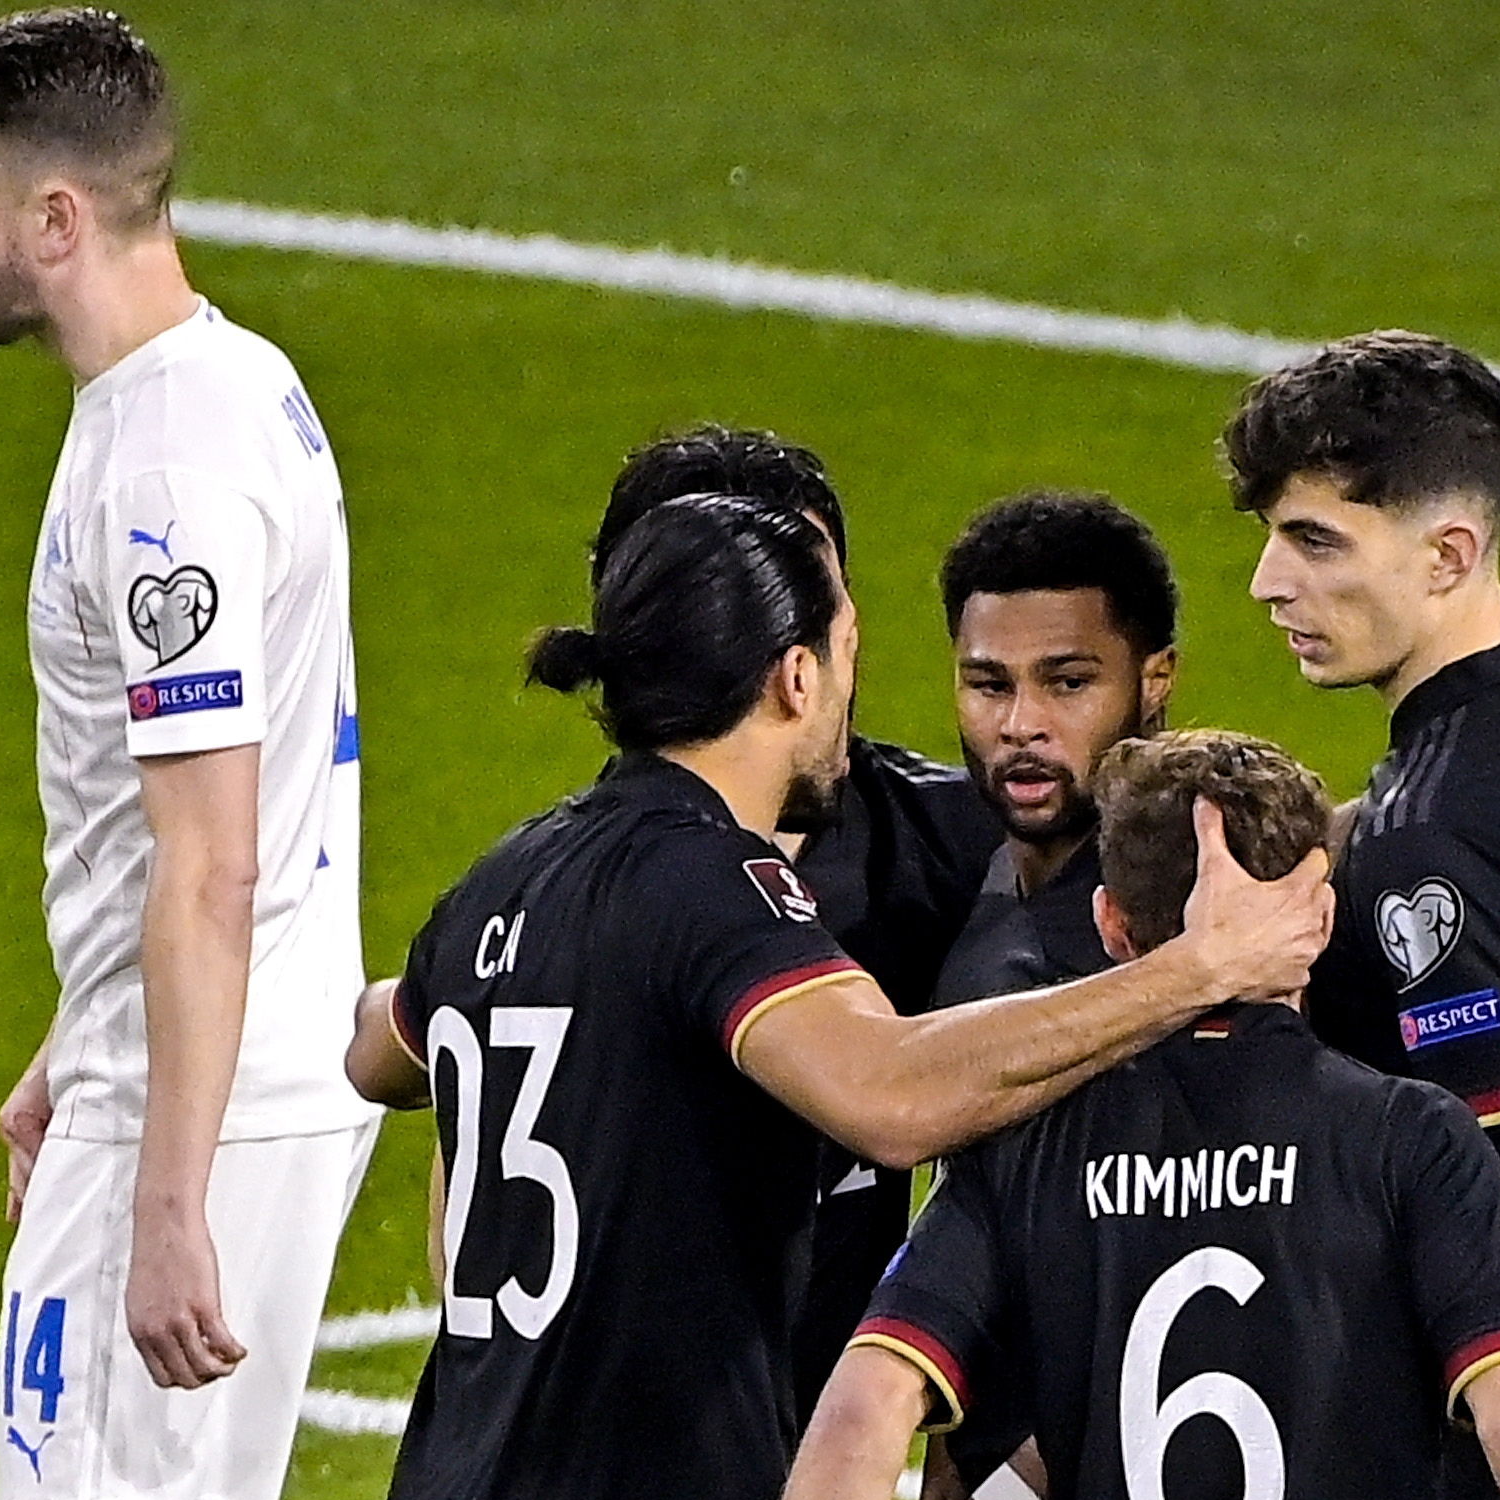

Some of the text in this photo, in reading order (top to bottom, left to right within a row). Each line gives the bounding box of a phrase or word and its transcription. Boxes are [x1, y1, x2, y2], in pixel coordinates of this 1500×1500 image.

[158, 679, 242, 707] RESPECT
[1416, 998, 1499, 1037] RESPECT
[426, 1004, 580, 1341] 23
[1086, 1143, 1299, 1220] KIMMICH
[3, 1290, 67, 1424] 14
